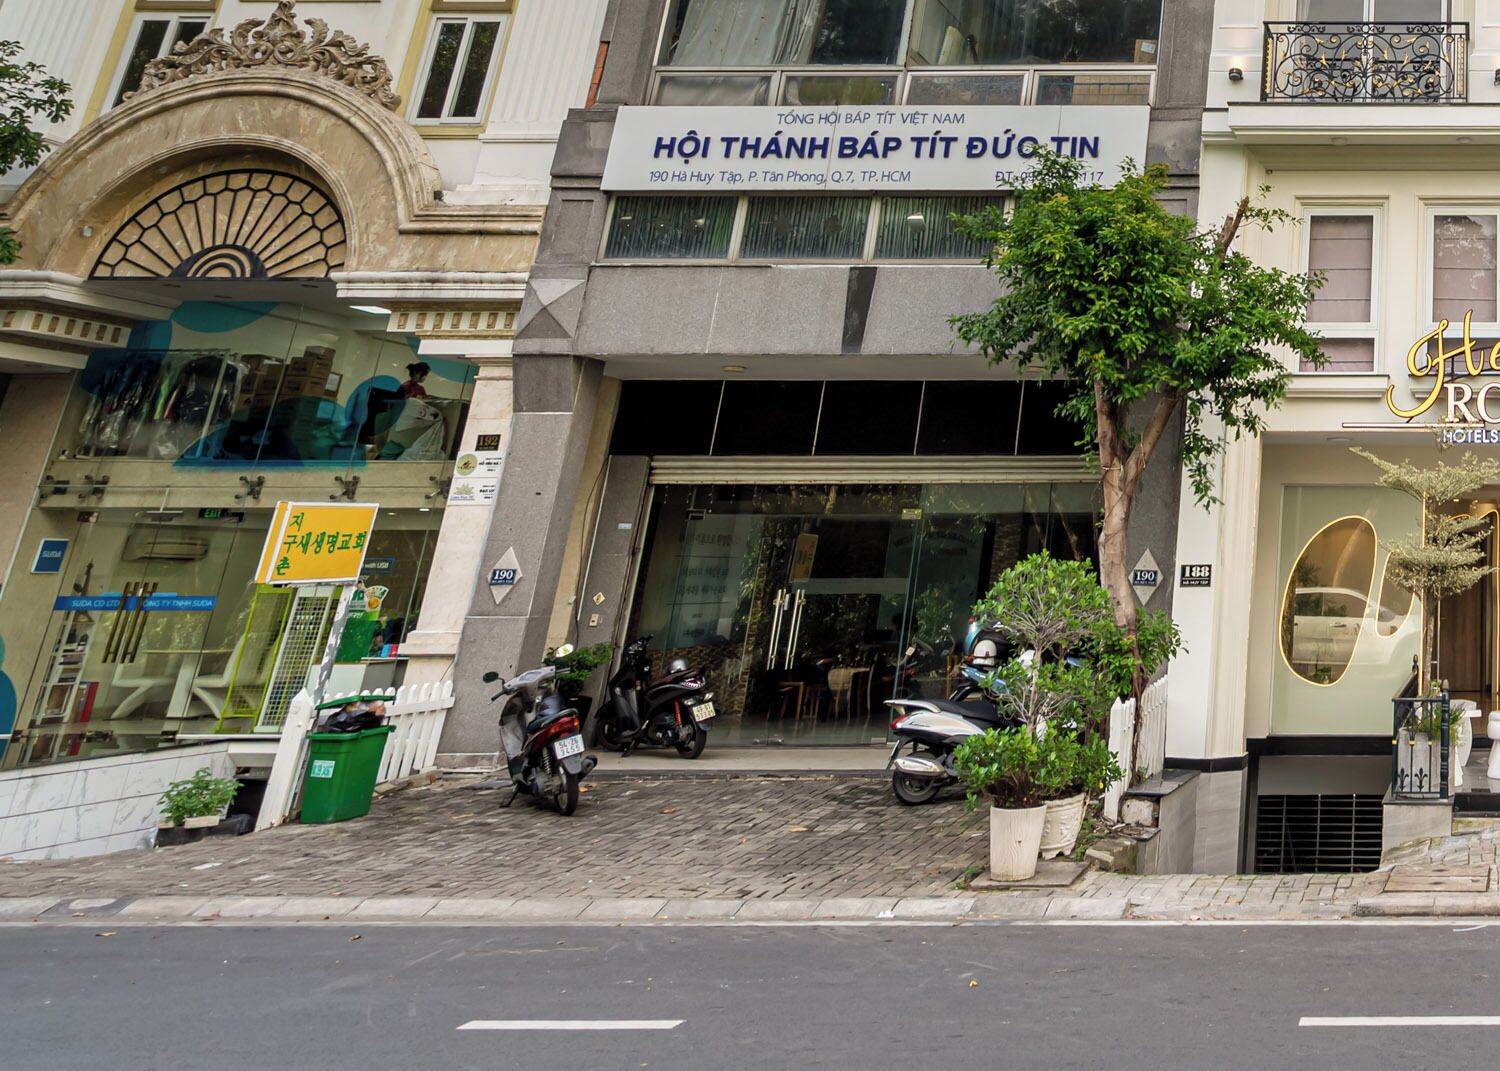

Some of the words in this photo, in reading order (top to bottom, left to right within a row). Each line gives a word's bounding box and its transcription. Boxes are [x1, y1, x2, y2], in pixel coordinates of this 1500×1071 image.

[777, 109, 815, 125] TỔNG
[818, 111, 842, 126] HỘI
[845, 111, 871, 125] BÁP
[876, 111, 896, 125] TÍT
[901, 110, 929, 127] VIỆT
[932, 112, 966, 125] NAM
[653, 129, 712, 165] HỘI
[720, 130, 830, 159] THÁNH
[837, 130, 903, 159] BÁP
[911, 130, 959, 159] TÍT
[966, 128, 1040, 159] ĐỨC
[1051, 135, 1101, 159] TIN
[650, 170, 669, 183] 190
[671, 170, 687, 183] Hà
[690, 170, 714, 186] Huy
[719, 170, 745, 186] Tập,
[786, 170, 828, 186] Phong,
[479, 435, 498, 446] 192
[1443, 430, 1498, 444] HOTELS
[493, 570, 514, 580] 190
[1136, 571, 1155, 581] 190
[1184, 566, 1210, 578] 188
[72, 599, 92, 608] SUDA
[192, 599, 212, 608] SUDA
